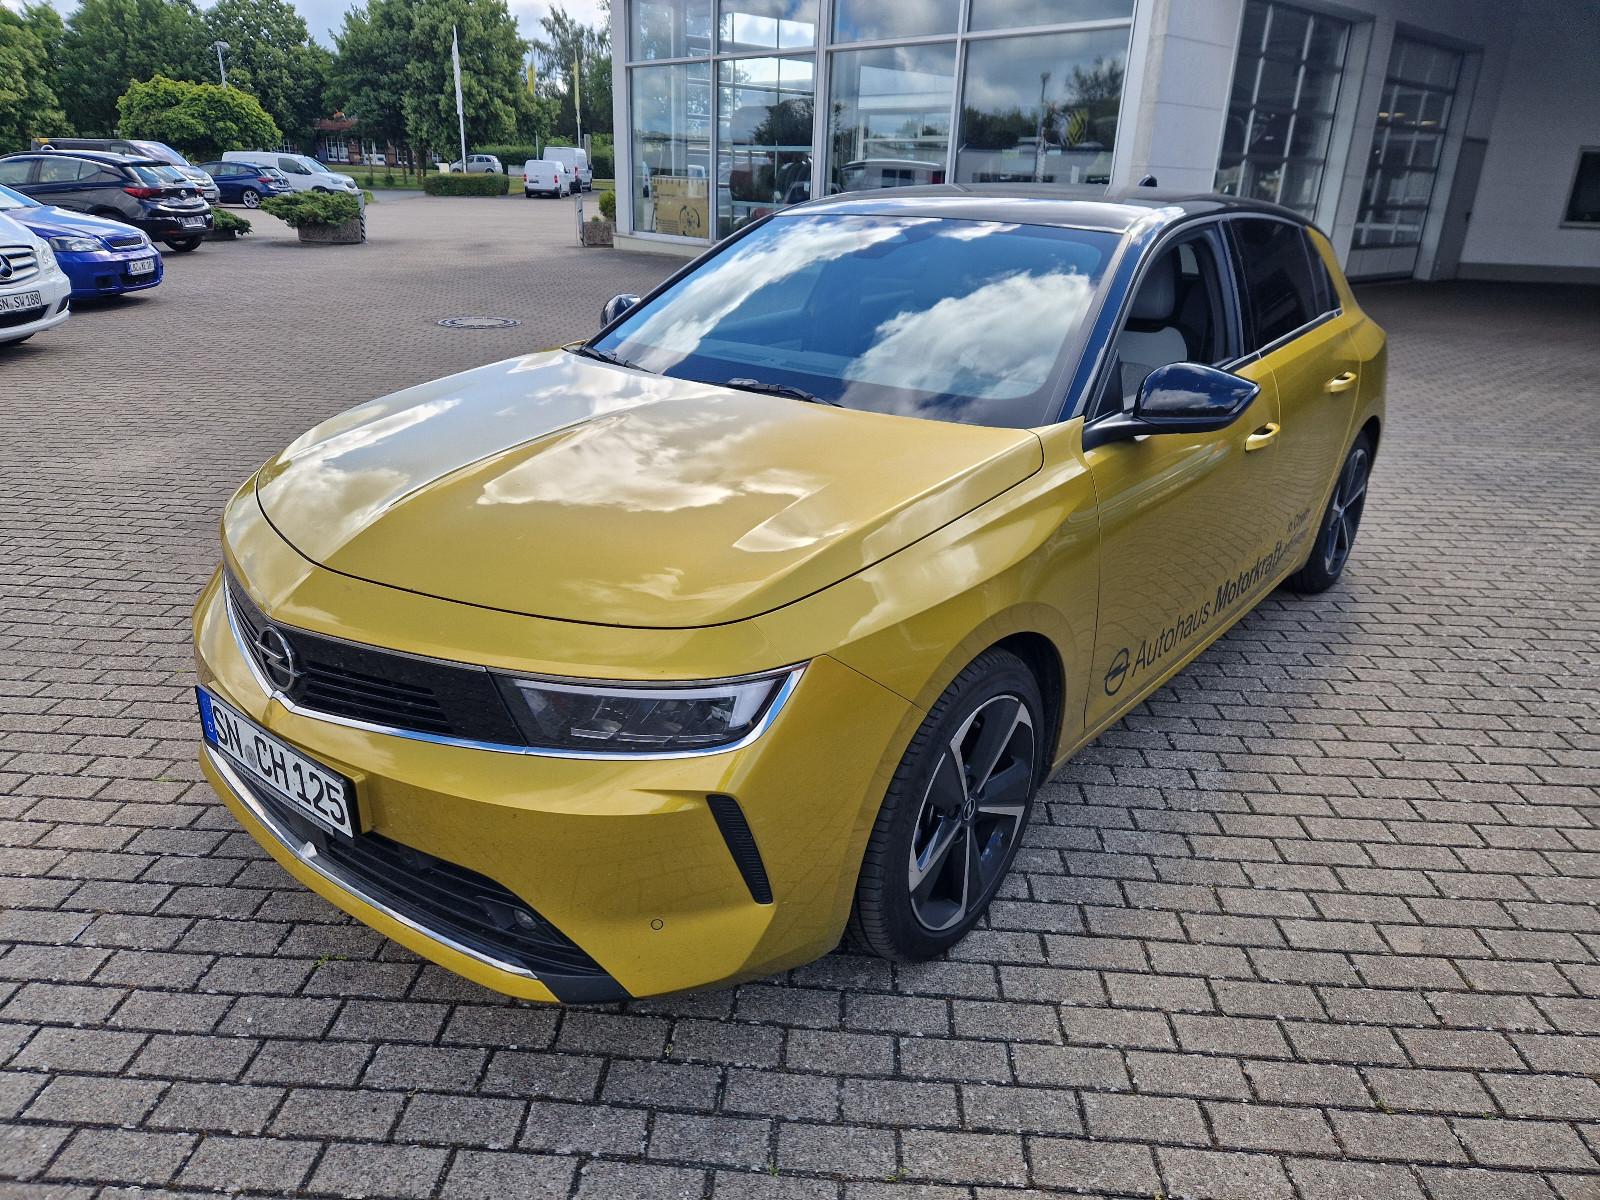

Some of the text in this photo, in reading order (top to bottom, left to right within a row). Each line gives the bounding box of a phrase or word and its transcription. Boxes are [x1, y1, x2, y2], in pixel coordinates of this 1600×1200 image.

[14, 295, 25, 308] SW
[1131, 540, 1284, 678] Autohaus Motorkraft
[212, 705, 244, 758] SN
[253, 735, 290, 791] CH
[293, 761, 346, 826] 125
